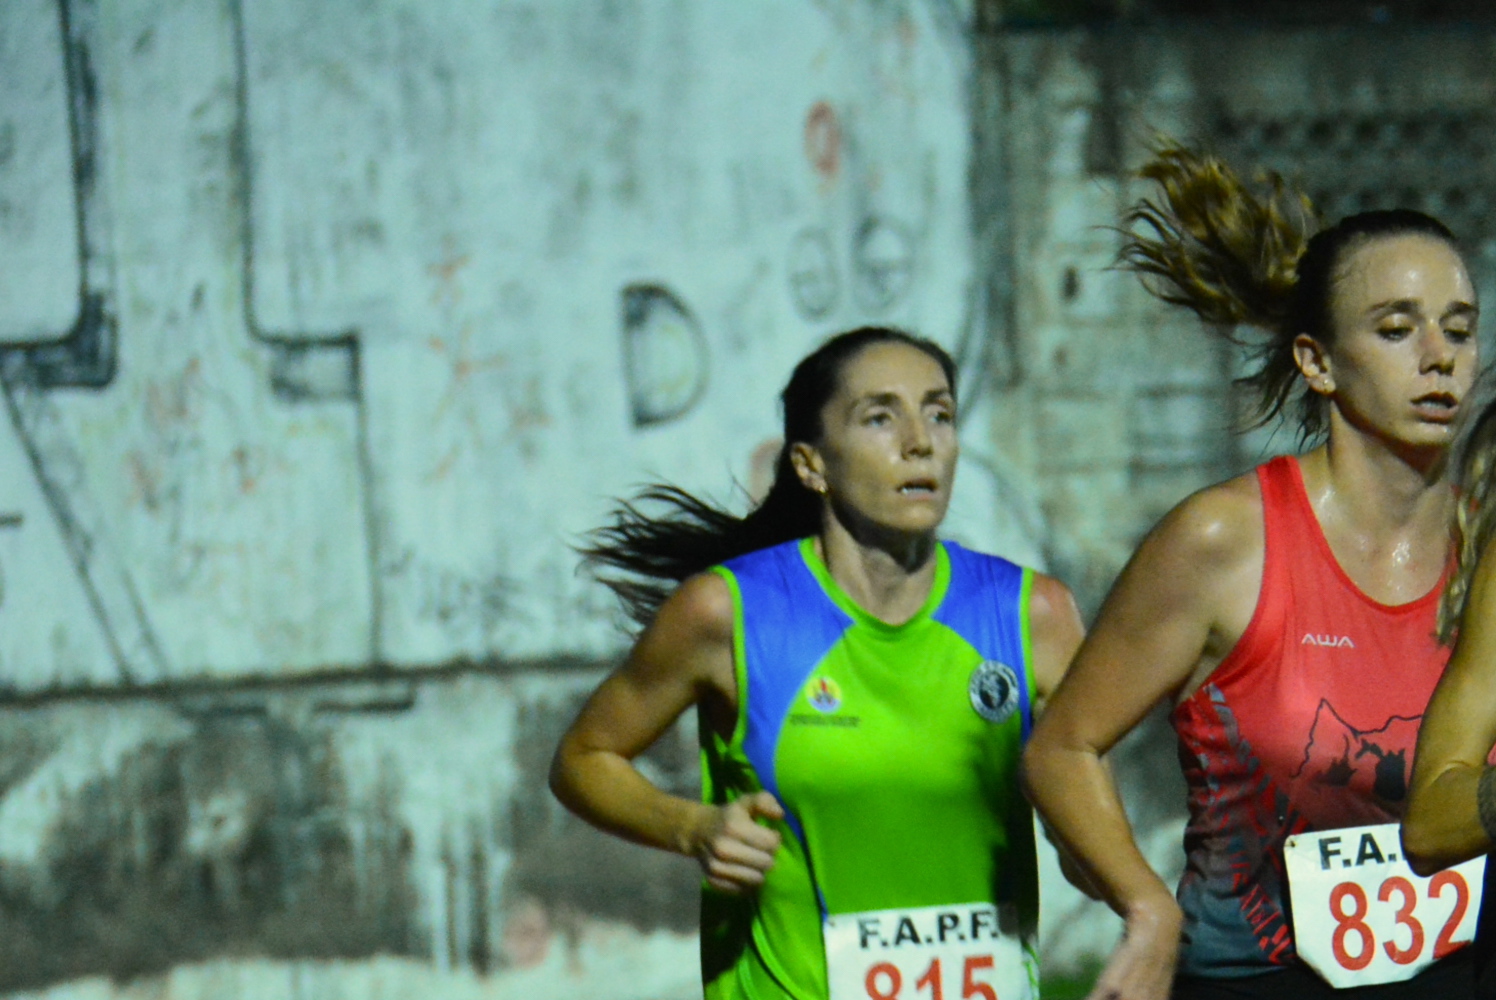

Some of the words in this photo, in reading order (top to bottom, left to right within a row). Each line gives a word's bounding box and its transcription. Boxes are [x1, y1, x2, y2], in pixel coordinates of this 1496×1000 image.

[1301, 633, 1355, 649] AWA
[858, 909, 1001, 949] F.A.P.F.
[1328, 869, 1473, 972] 832
